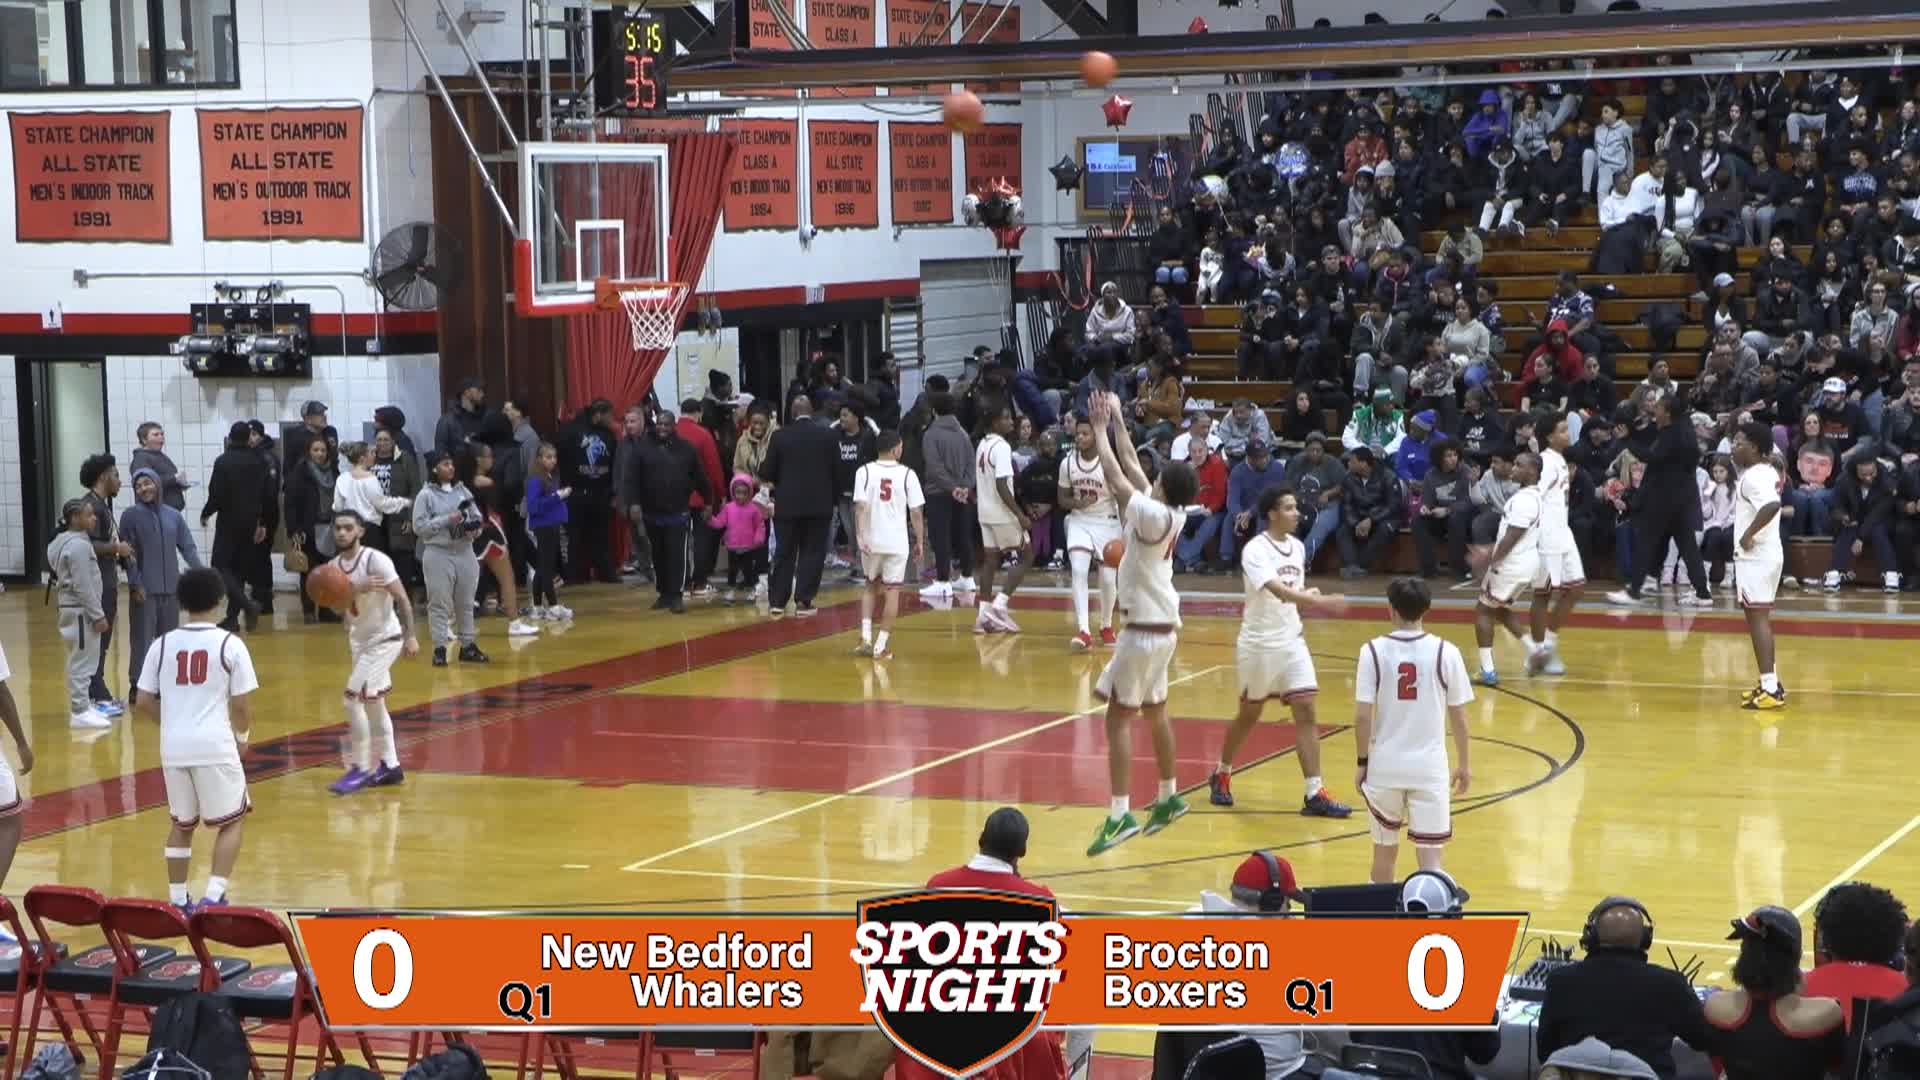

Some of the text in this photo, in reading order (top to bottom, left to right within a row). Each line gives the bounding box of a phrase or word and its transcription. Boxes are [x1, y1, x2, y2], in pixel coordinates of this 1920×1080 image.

[812, 1, 870, 20] STATE CHAMPION
[625, 22, 661, 53] 5:15
[752, 21, 782, 38] STATE
[825, 26, 858, 42] CLASS A
[624, 55, 656, 108] 35
[25, 125, 154, 145] STATE CHAMPION
[214, 122, 347, 141] STATE CHAMPION
[42, 154, 141, 172] ALL STATE
[231, 152, 333, 170] ALL STATE
[743, 154, 777, 170] CLASS A
[826, 154, 863, 172] ALL STATE
[30, 182, 154, 201] MEN'S INDOOR TRACK
[213, 180, 351, 200] MEN'S OUTDOOR TRACK
[73, 212, 112, 227] 1991
[263, 210, 304, 225] 1991
[879, 478, 892, 502] 5
[175, 649, 209, 686] 10
[1397, 661, 1418, 701] 2
